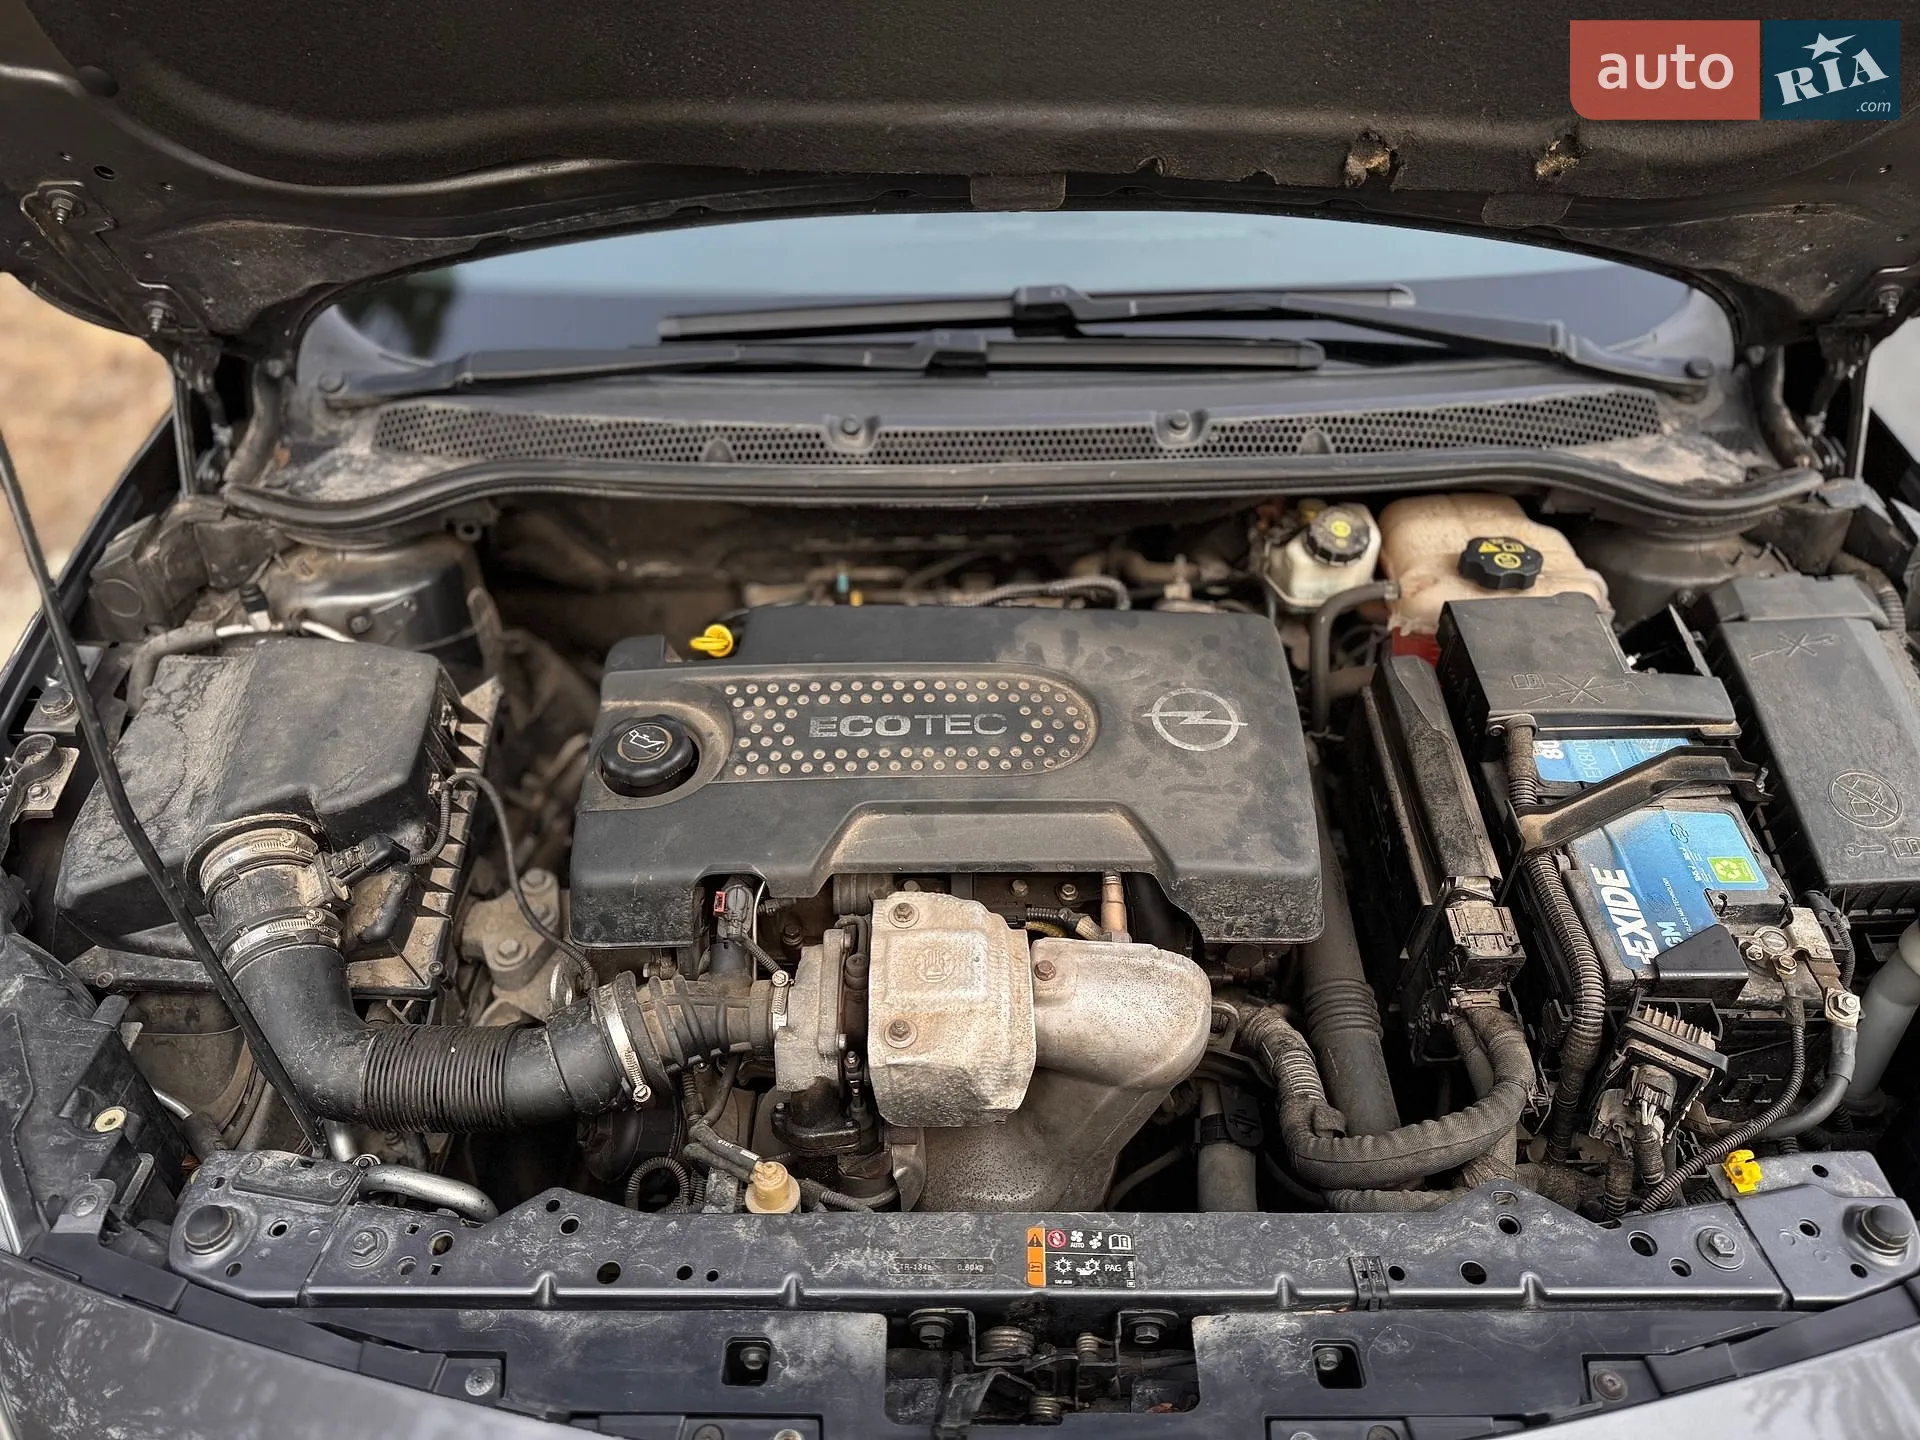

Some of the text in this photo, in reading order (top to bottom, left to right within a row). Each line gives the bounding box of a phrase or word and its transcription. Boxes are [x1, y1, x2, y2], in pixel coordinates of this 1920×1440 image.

[808, 713, 1008, 738] ECOTEC
[1590, 866, 1660, 964] EXIDE
[1657, 921, 1685, 948] GM
[1104, 1263, 1122, 1273] PAG
